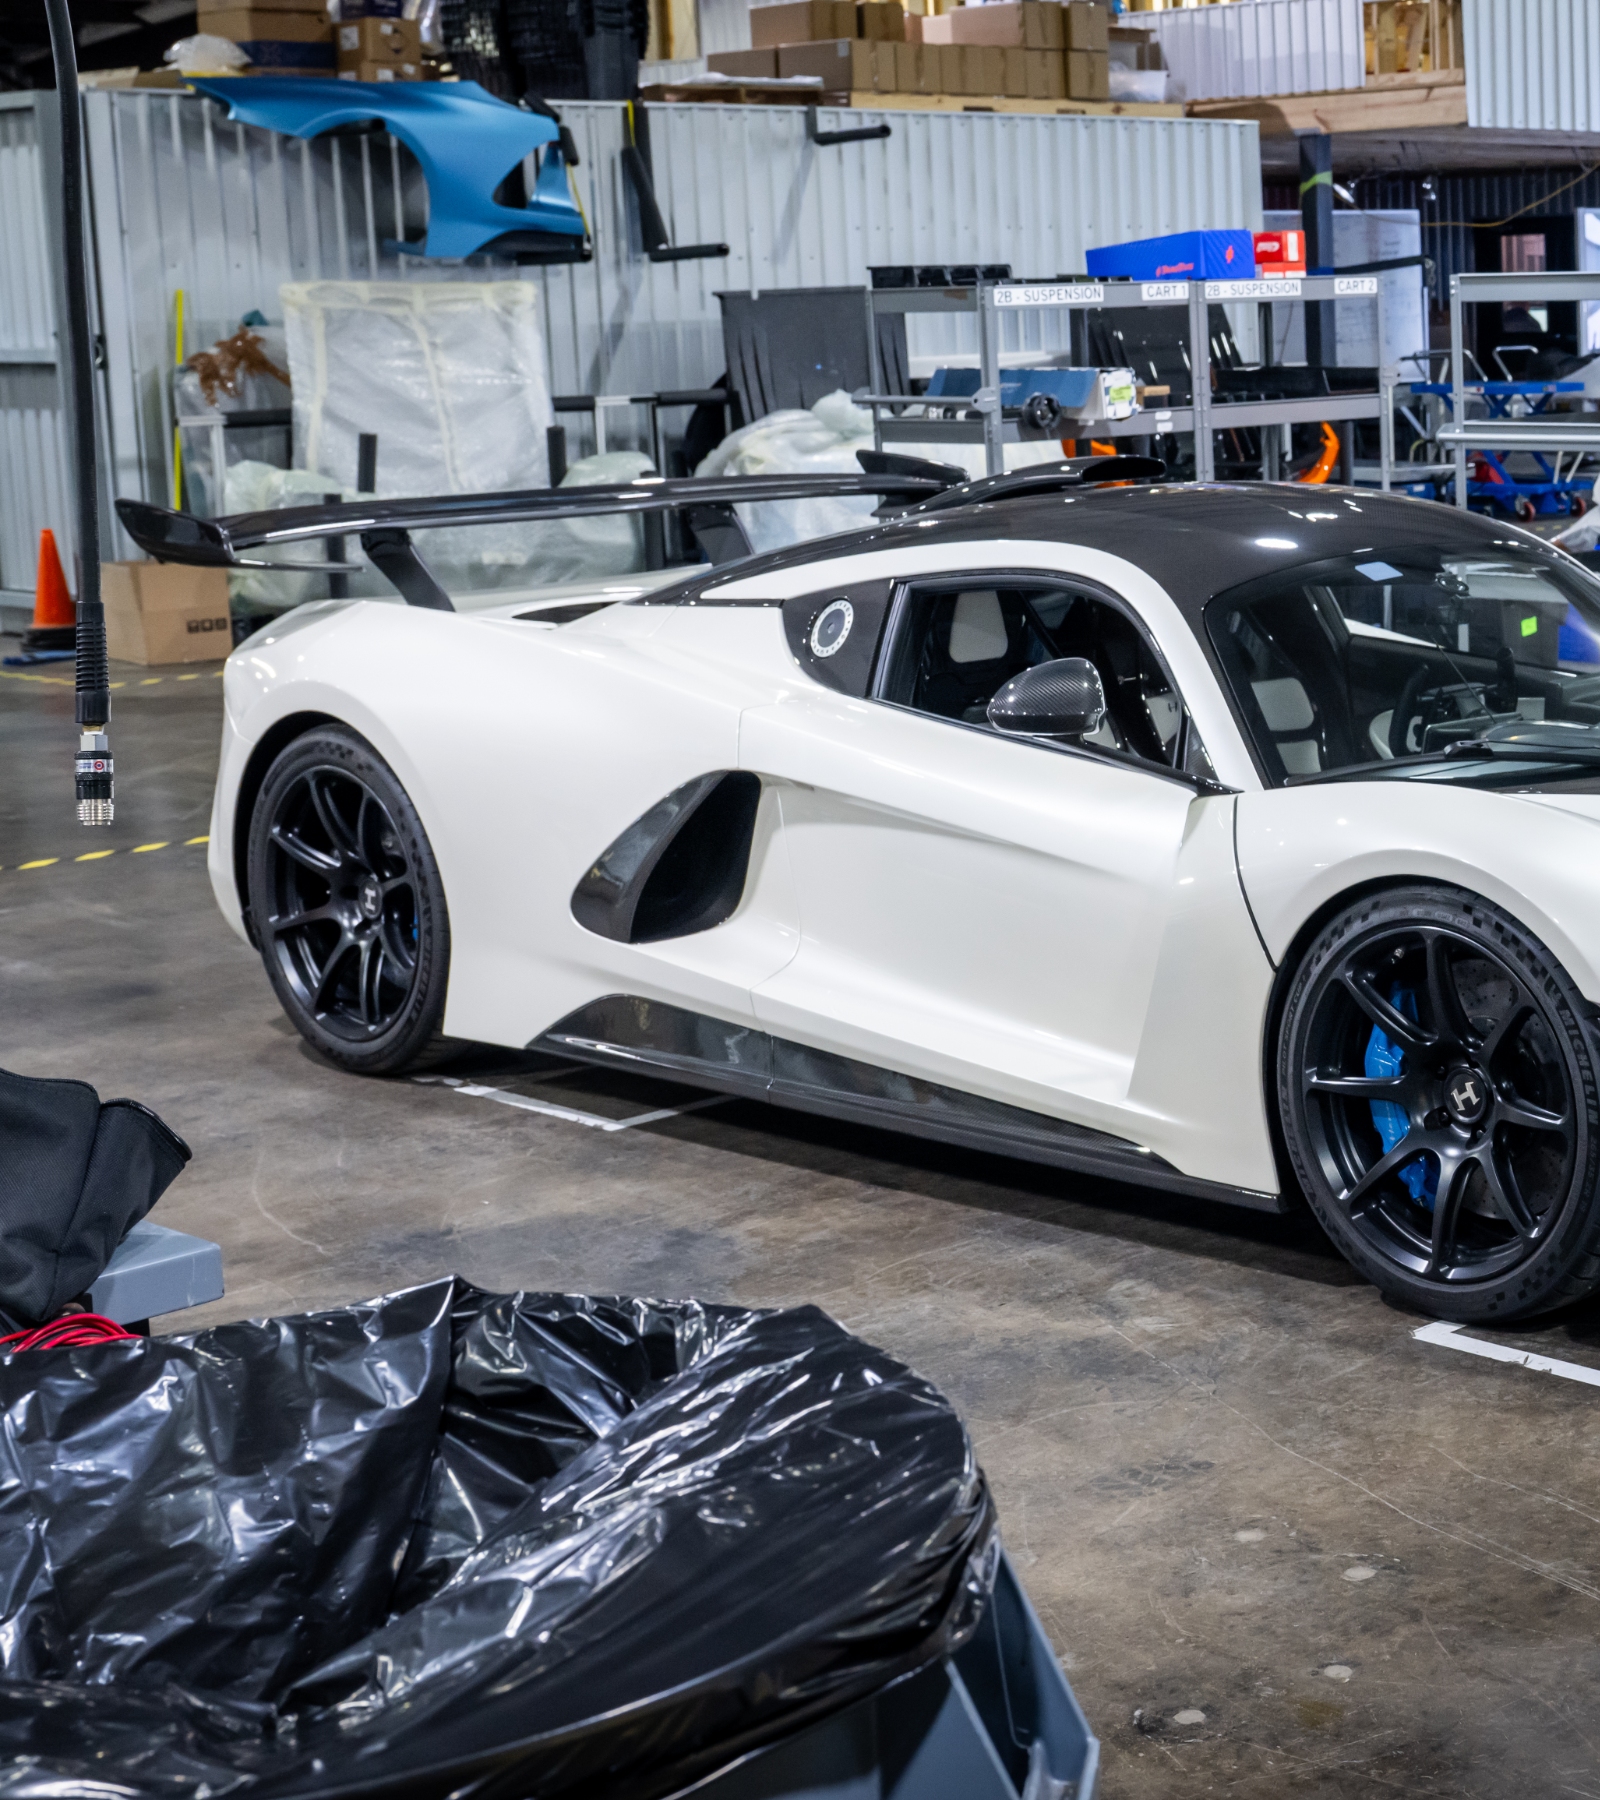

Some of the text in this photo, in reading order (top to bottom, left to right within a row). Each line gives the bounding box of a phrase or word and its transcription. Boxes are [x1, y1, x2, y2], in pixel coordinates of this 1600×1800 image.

[1146, 284, 1186, 298] CART 1
[1207, 284, 1220, 297] 2B
[1230, 281, 1299, 296] SUSPENSION
[1337, 279, 1375, 292] CART 2
[997, 290, 1013, 304] 2B
[1024, 286, 1100, 302] SUSPENSION
[1560, 1009, 1599, 1125] MICHELIN
[1450, 1081, 1481, 1111] H
